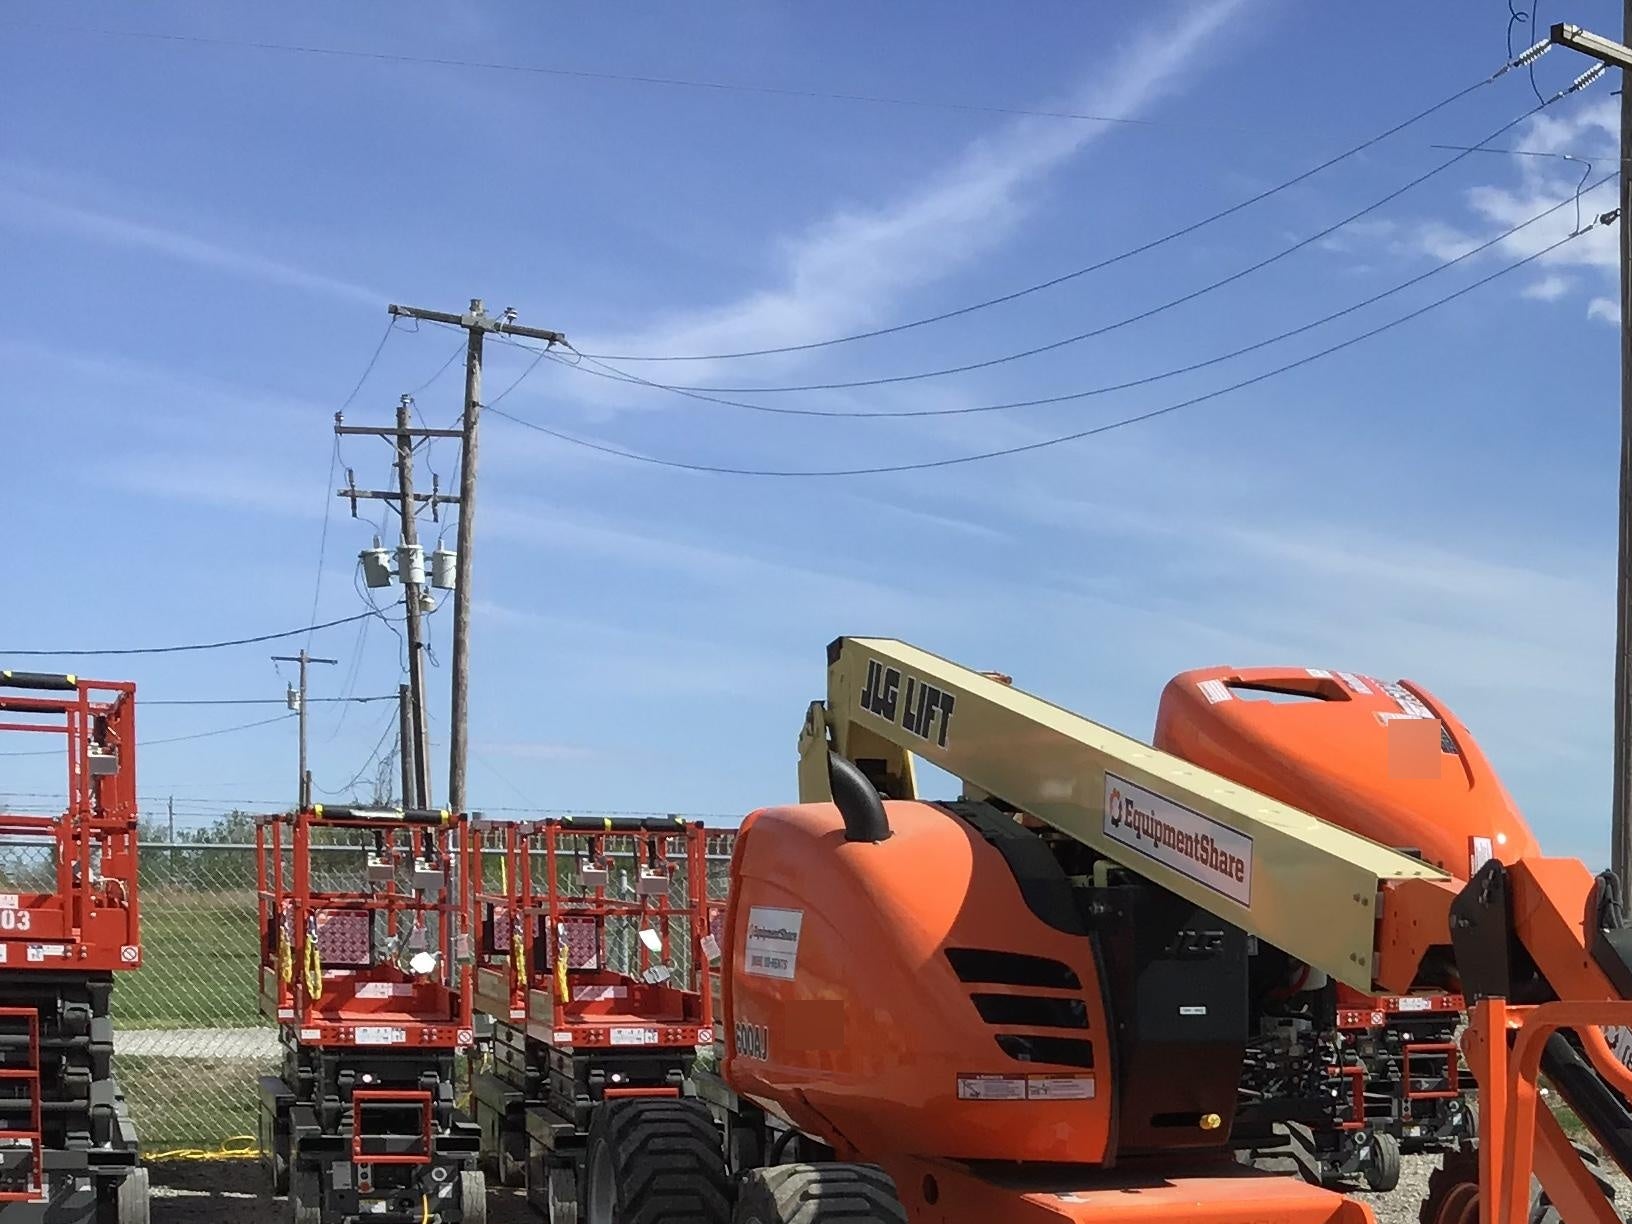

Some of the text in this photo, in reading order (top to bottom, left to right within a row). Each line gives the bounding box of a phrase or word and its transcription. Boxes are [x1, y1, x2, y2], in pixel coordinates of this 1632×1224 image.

[860, 658, 956, 751] JLG LIFT
[1124, 797, 1245, 883] EquipmentShare
